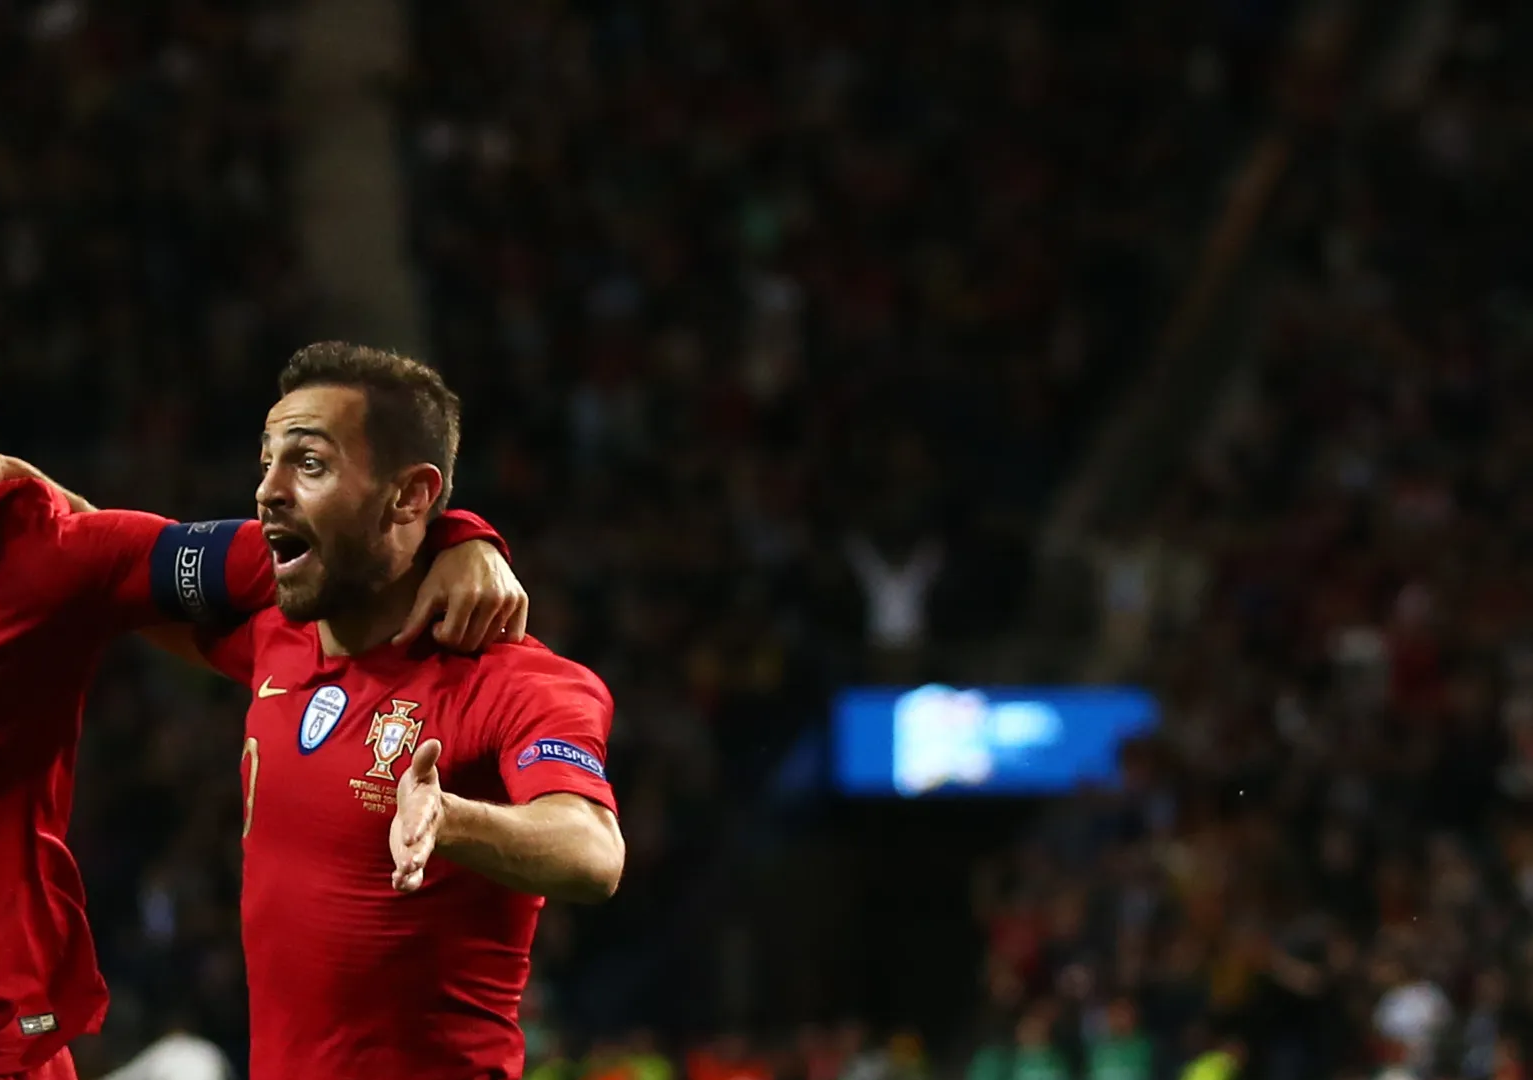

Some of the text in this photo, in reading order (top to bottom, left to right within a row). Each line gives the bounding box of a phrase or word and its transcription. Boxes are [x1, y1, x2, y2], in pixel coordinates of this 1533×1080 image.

[180, 546, 202, 608] ESPECT
[541, 744, 604, 774] RESPECT
[349, 779, 382, 793] PORTUGAL
[363, 801, 386, 813] PORTO
